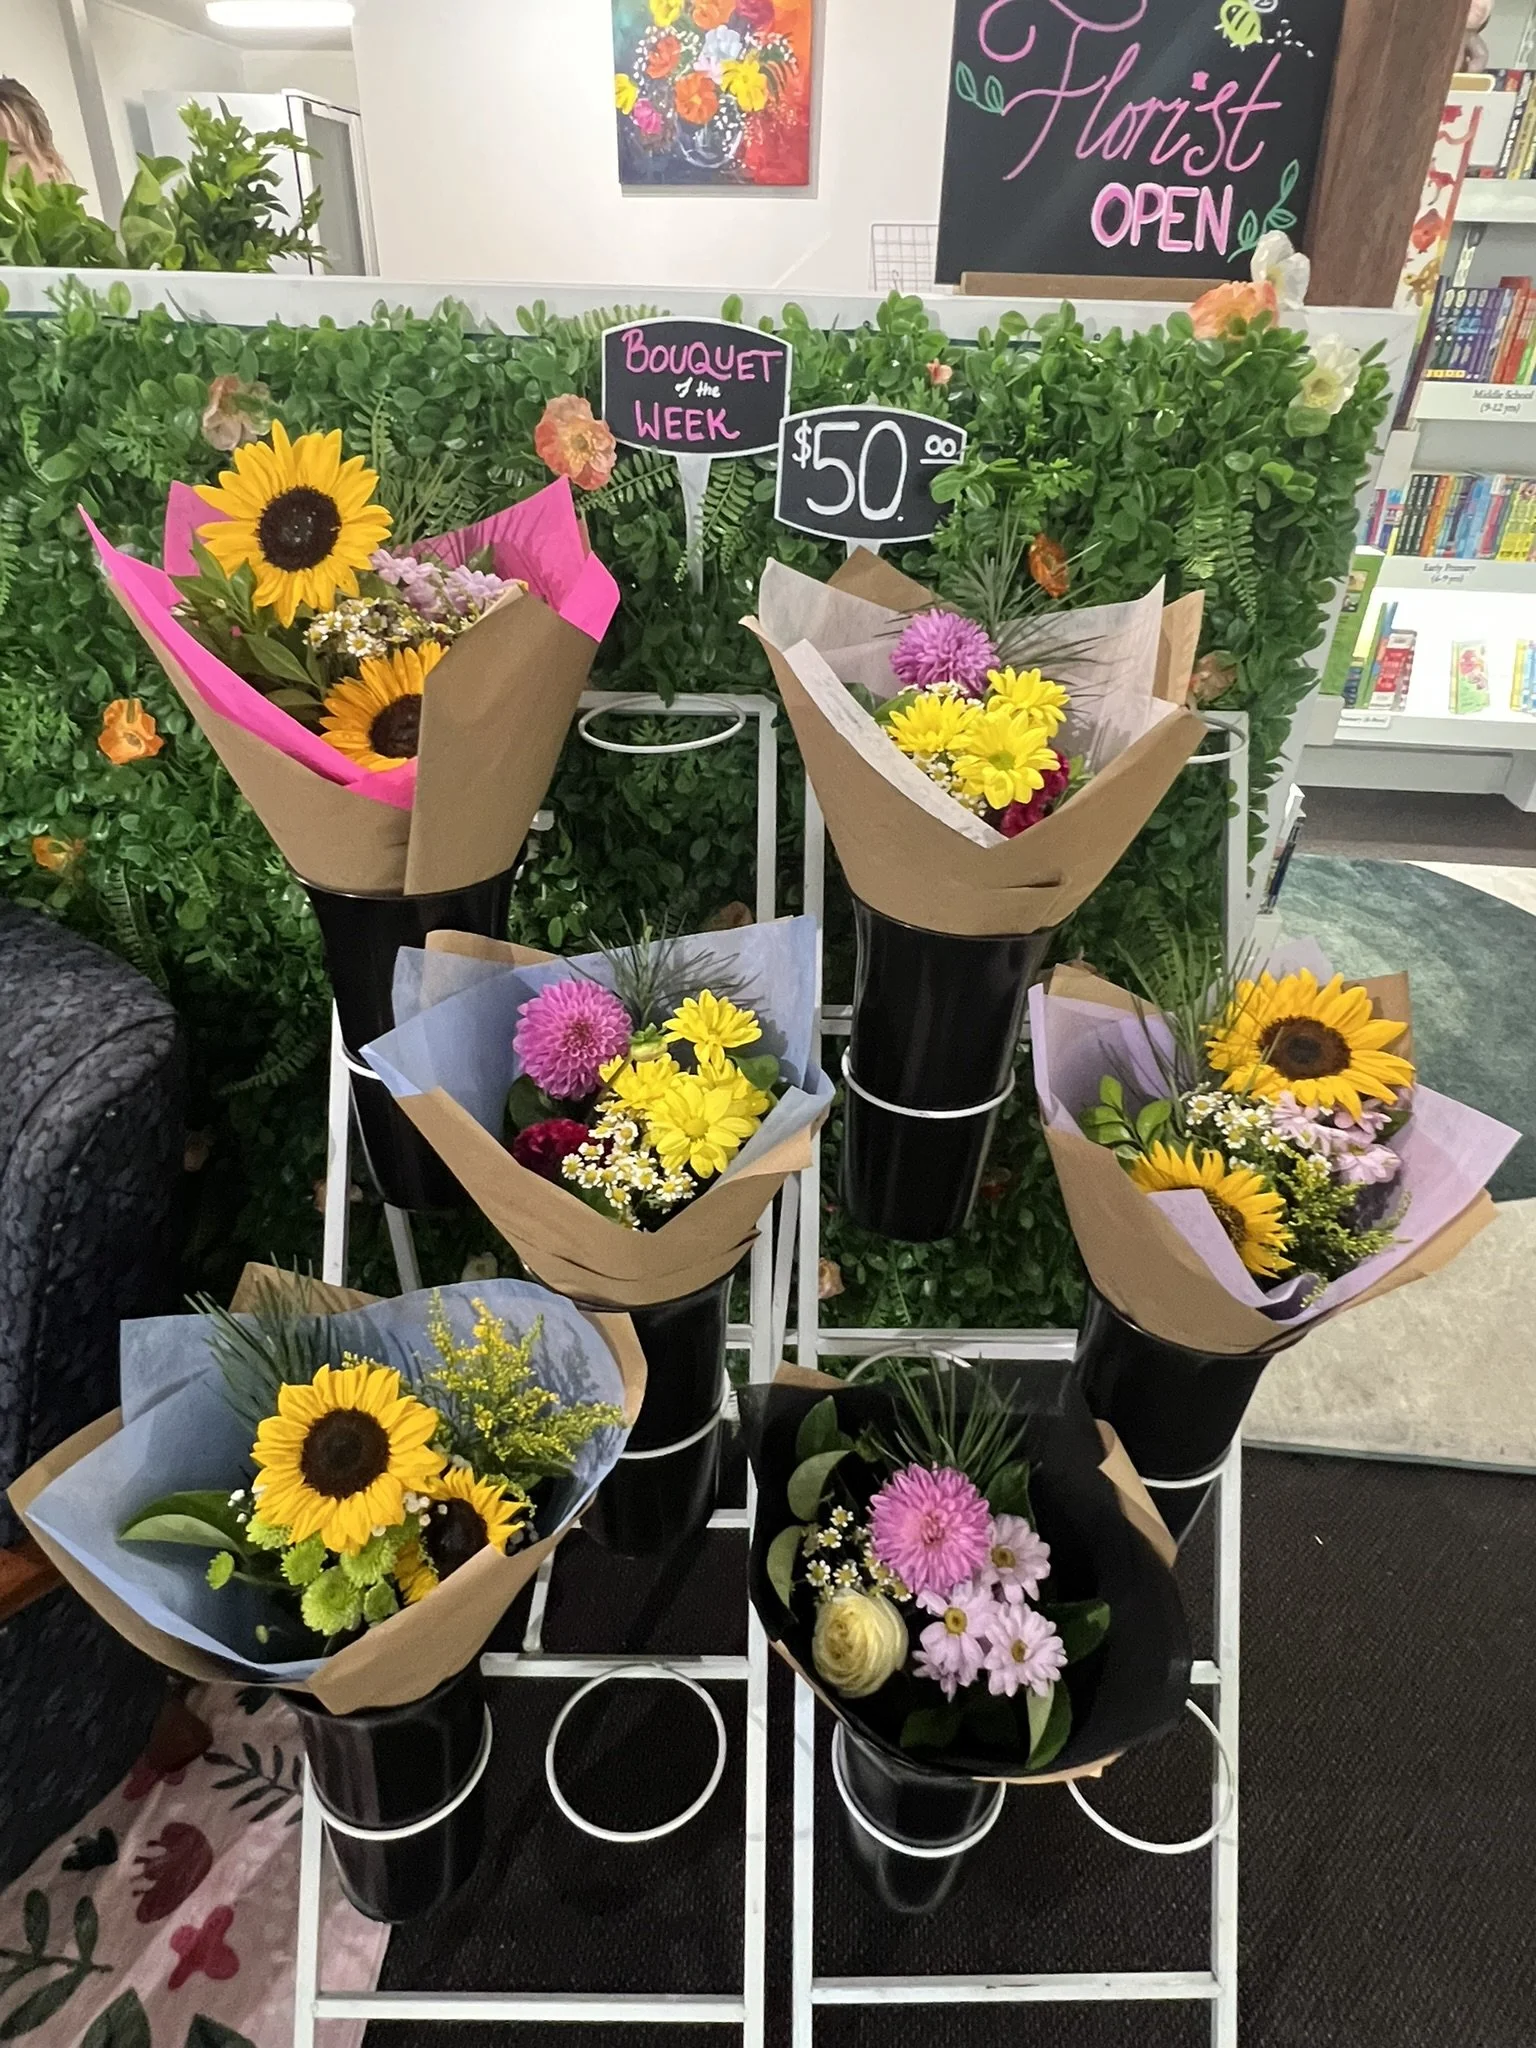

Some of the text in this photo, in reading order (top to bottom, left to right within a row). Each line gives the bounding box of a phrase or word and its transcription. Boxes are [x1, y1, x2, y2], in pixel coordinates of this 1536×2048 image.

[978, 0, 1283, 181] Florist
[1090, 182, 1234, 256] OPEN
[696, 380, 721, 399] the
[1472, 389, 1535, 400] Middle School
[633, 400, 741, 442] WEEK
